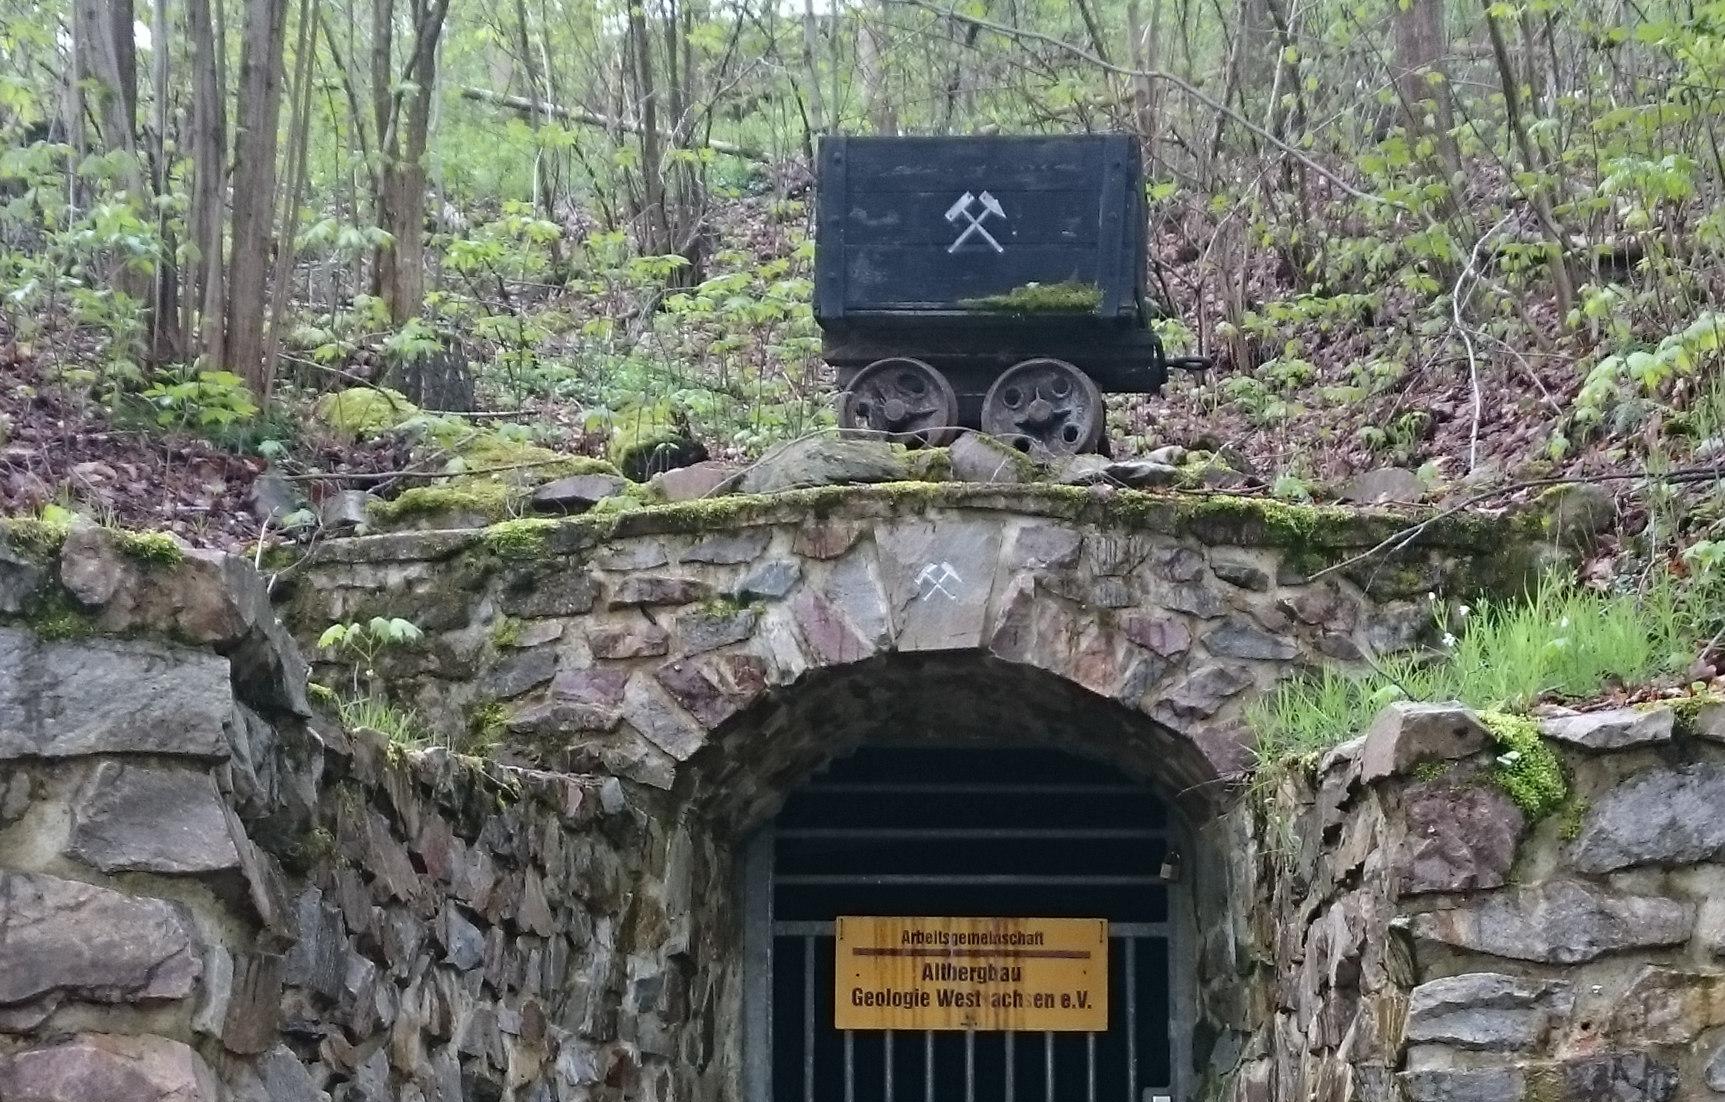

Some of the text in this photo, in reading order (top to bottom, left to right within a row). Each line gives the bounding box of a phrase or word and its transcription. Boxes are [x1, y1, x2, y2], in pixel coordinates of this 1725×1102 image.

[901, 930, 1044, 946] Arbeitsgemeinschaft
[922, 963, 1021, 983] Altbergbau
[851, 987, 931, 1009] Geologie
[1060, 990, 1092, 1010] e.V.
